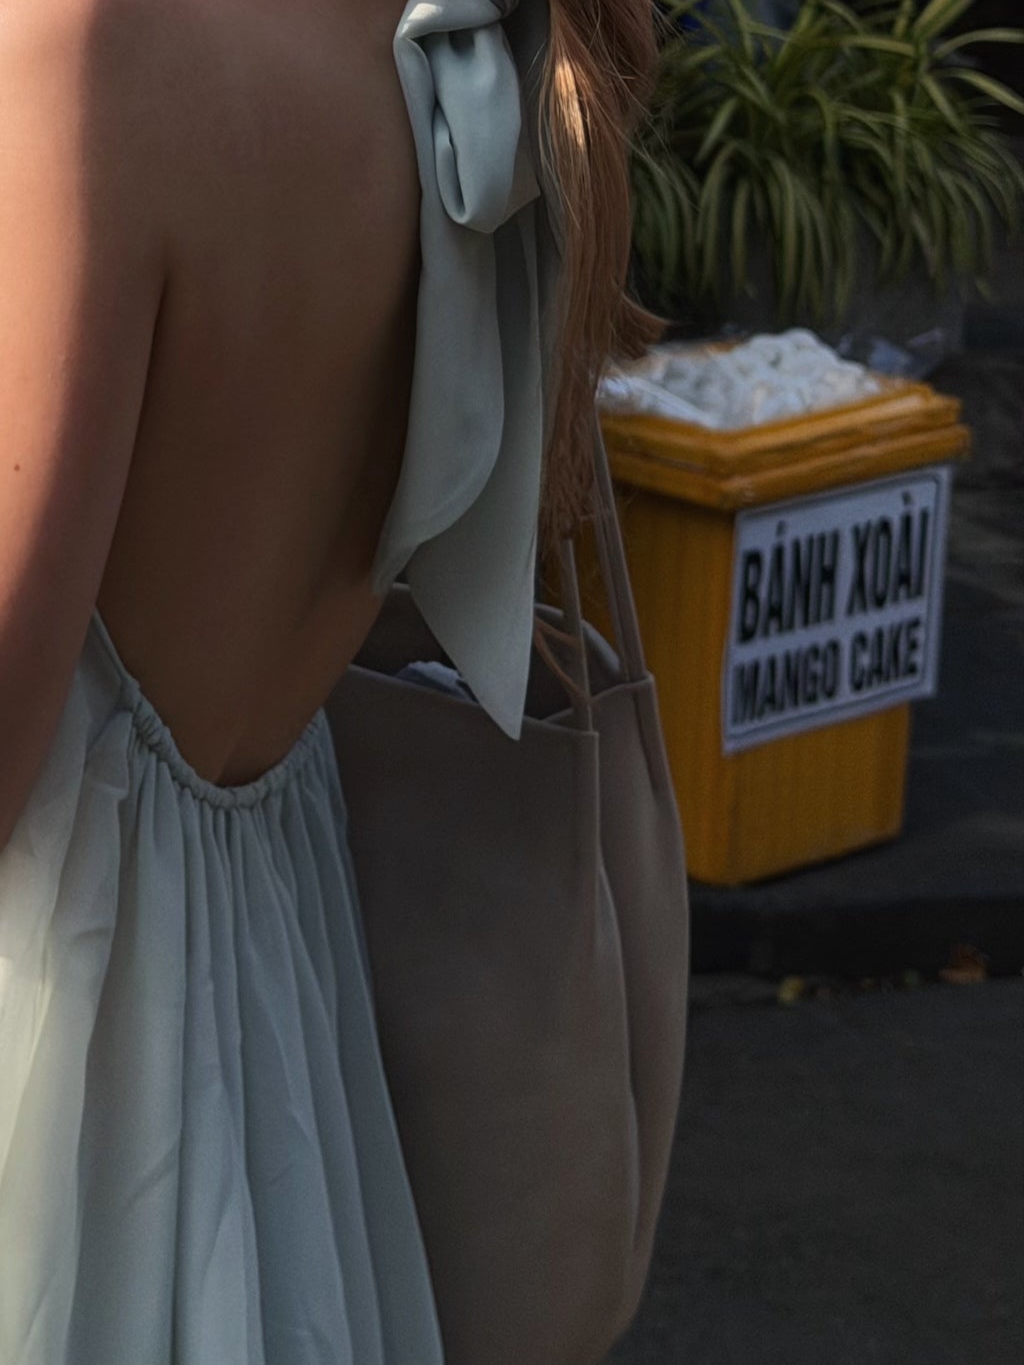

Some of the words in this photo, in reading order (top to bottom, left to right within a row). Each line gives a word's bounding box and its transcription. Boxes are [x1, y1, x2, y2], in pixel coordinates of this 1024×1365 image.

[738, 521, 840, 644] BÁNH
[846, 491, 930, 617] XOÀI
[731, 639, 842, 724] MANGO
[849, 618, 922, 693] CAKE
